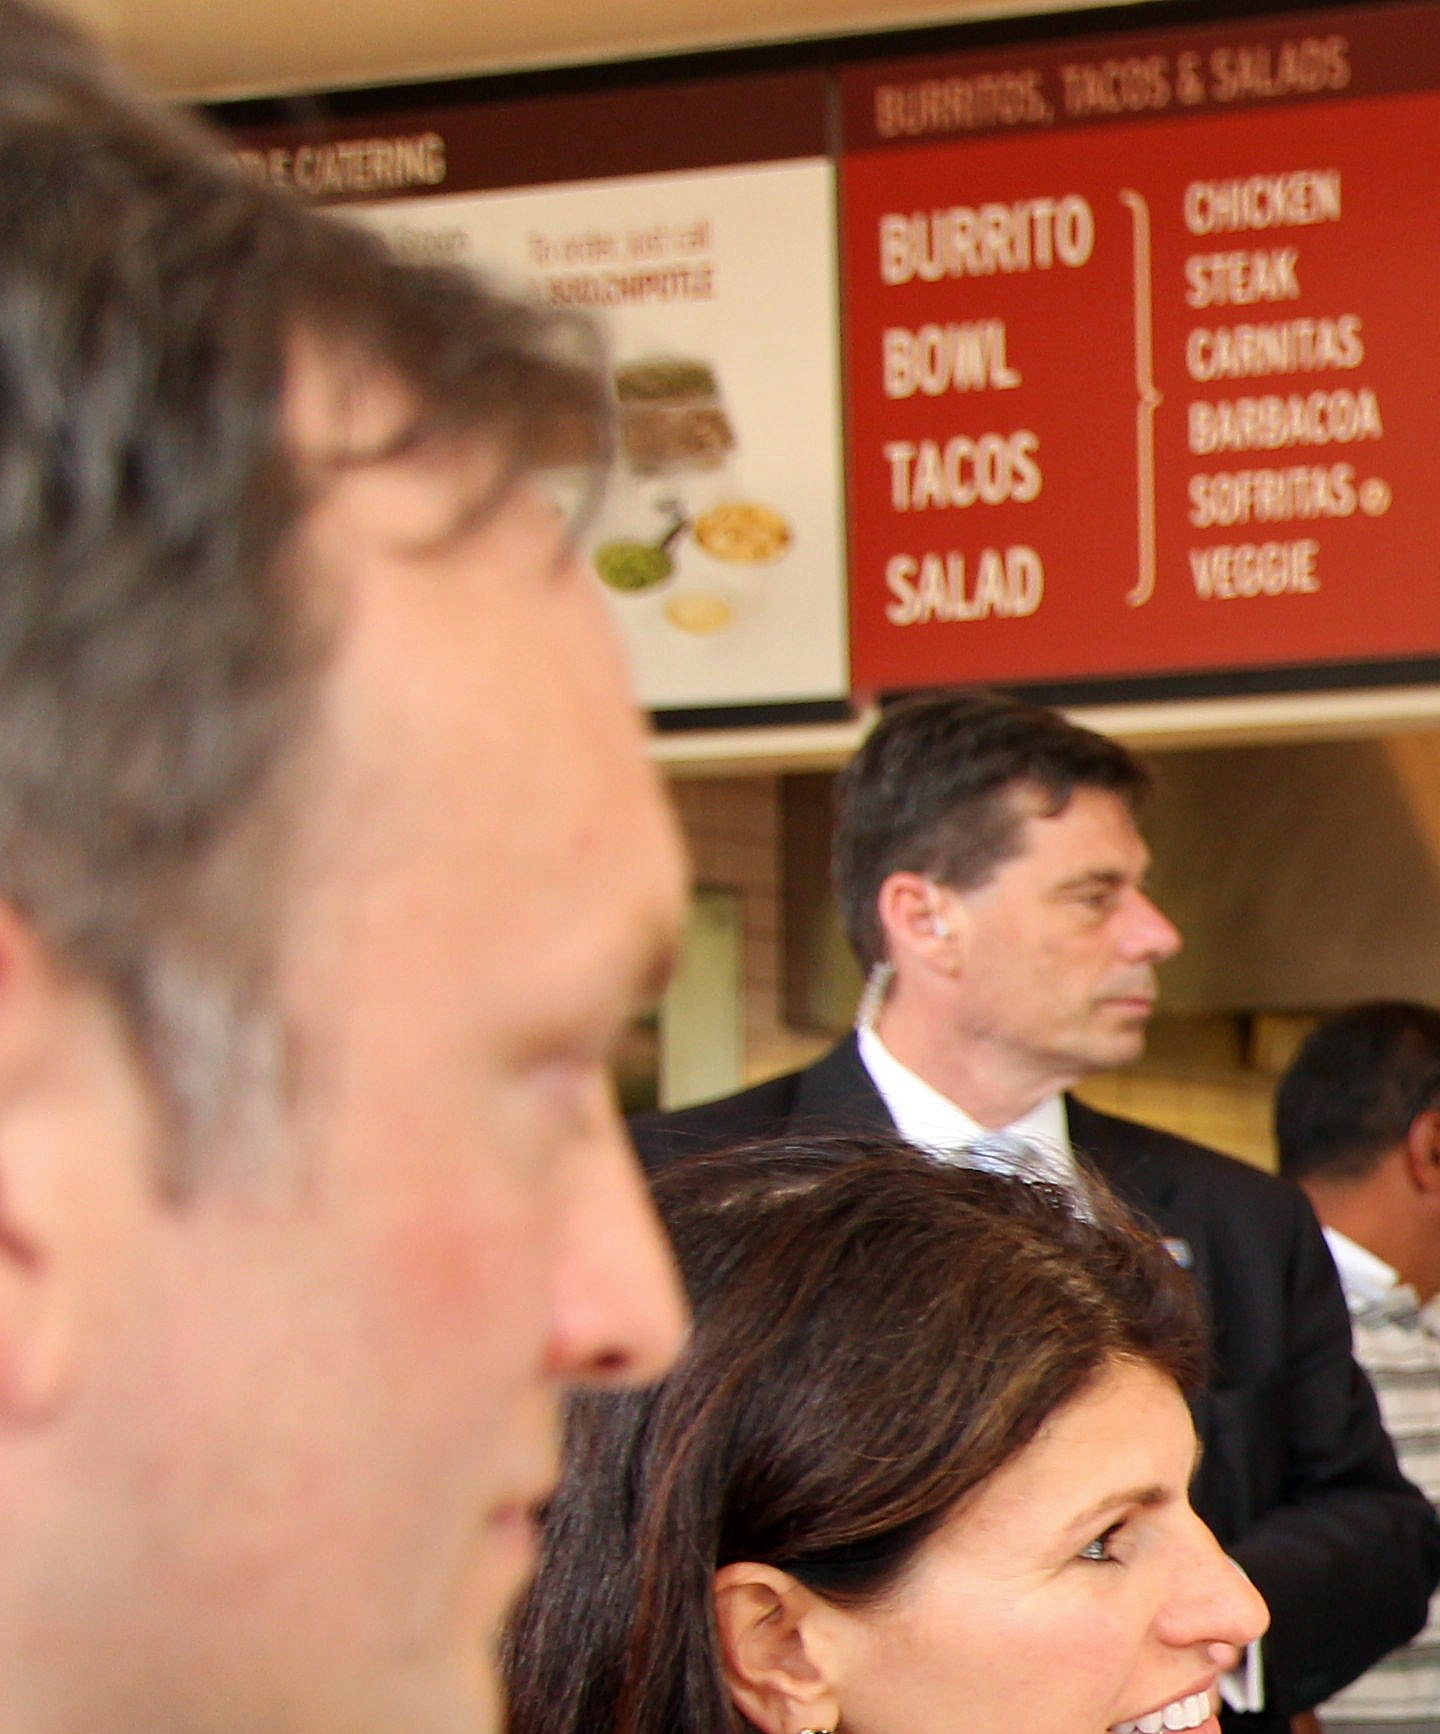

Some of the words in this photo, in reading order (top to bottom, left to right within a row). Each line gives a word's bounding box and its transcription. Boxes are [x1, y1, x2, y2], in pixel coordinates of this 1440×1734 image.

[875, 69, 1054, 137] BURRITOS,
[1064, 53, 1168, 117] TACOS
[1176, 52, 1203, 105] &
[1211, 36, 1351, 102] SALADS
[1184, 169, 1341, 235] CHICKEN
[879, 195, 1094, 286] BURRITO
[1185, 247, 1300, 308] STEAK
[883, 319, 1021, 399] BOWL
[1186, 313, 1363, 382] CARNITAS
[1187, 388, 1383, 455] BARBACOA
[882, 430, 1042, 511] TACOS
[1188, 463, 1357, 529] SOFRITAS
[885, 544, 1044, 627] SALAD
[1189, 539, 1321, 601] VEGGIE
